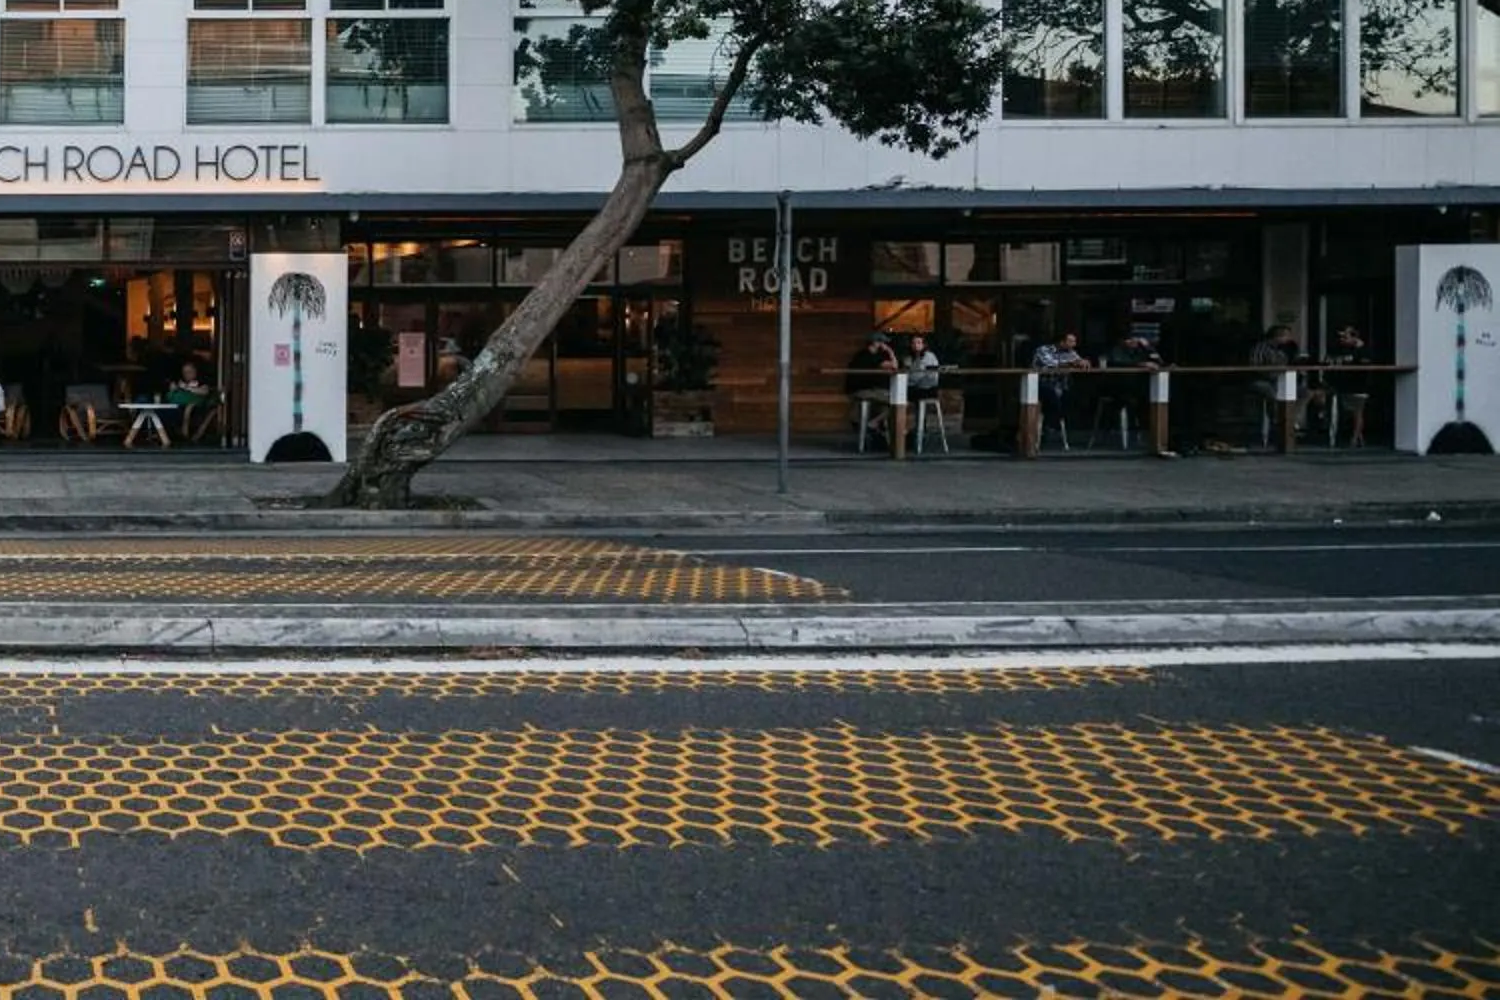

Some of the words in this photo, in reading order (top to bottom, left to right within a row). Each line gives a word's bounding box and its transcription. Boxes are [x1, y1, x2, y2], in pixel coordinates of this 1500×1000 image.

[63, 145, 181, 183] ROAD
[195, 144, 321, 182] HOTEL
[728, 237, 838, 263] BECH
[739, 266, 828, 293] ROAD
